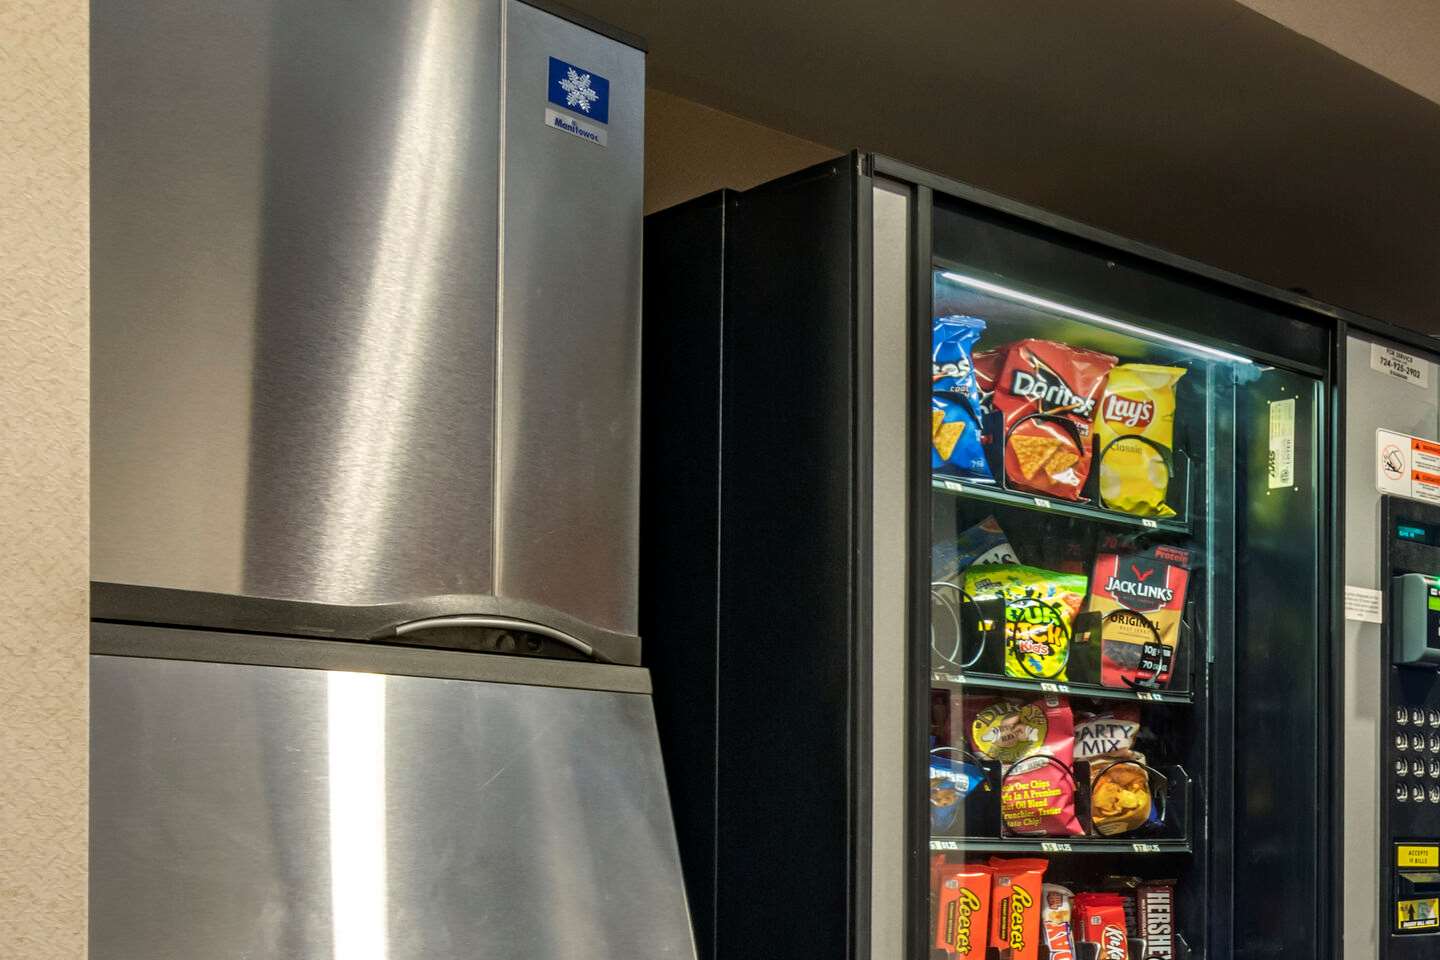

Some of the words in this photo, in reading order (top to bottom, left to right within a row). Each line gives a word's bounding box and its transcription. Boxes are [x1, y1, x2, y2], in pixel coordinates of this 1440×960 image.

[554, 116, 600, 143] Manitowoc
[1014, 371, 1096, 416] Doritos
[1105, 394, 1152, 428] Lay's
[1105, 577, 1137, 597] JACK
[1137, 582, 1174, 602] LINK'S
[1076, 724, 1133, 742] ARTY
[1083, 739, 1121, 756] MIX
[957, 887, 982, 957] Reese's
[1010, 884, 1033, 951] Reese's
